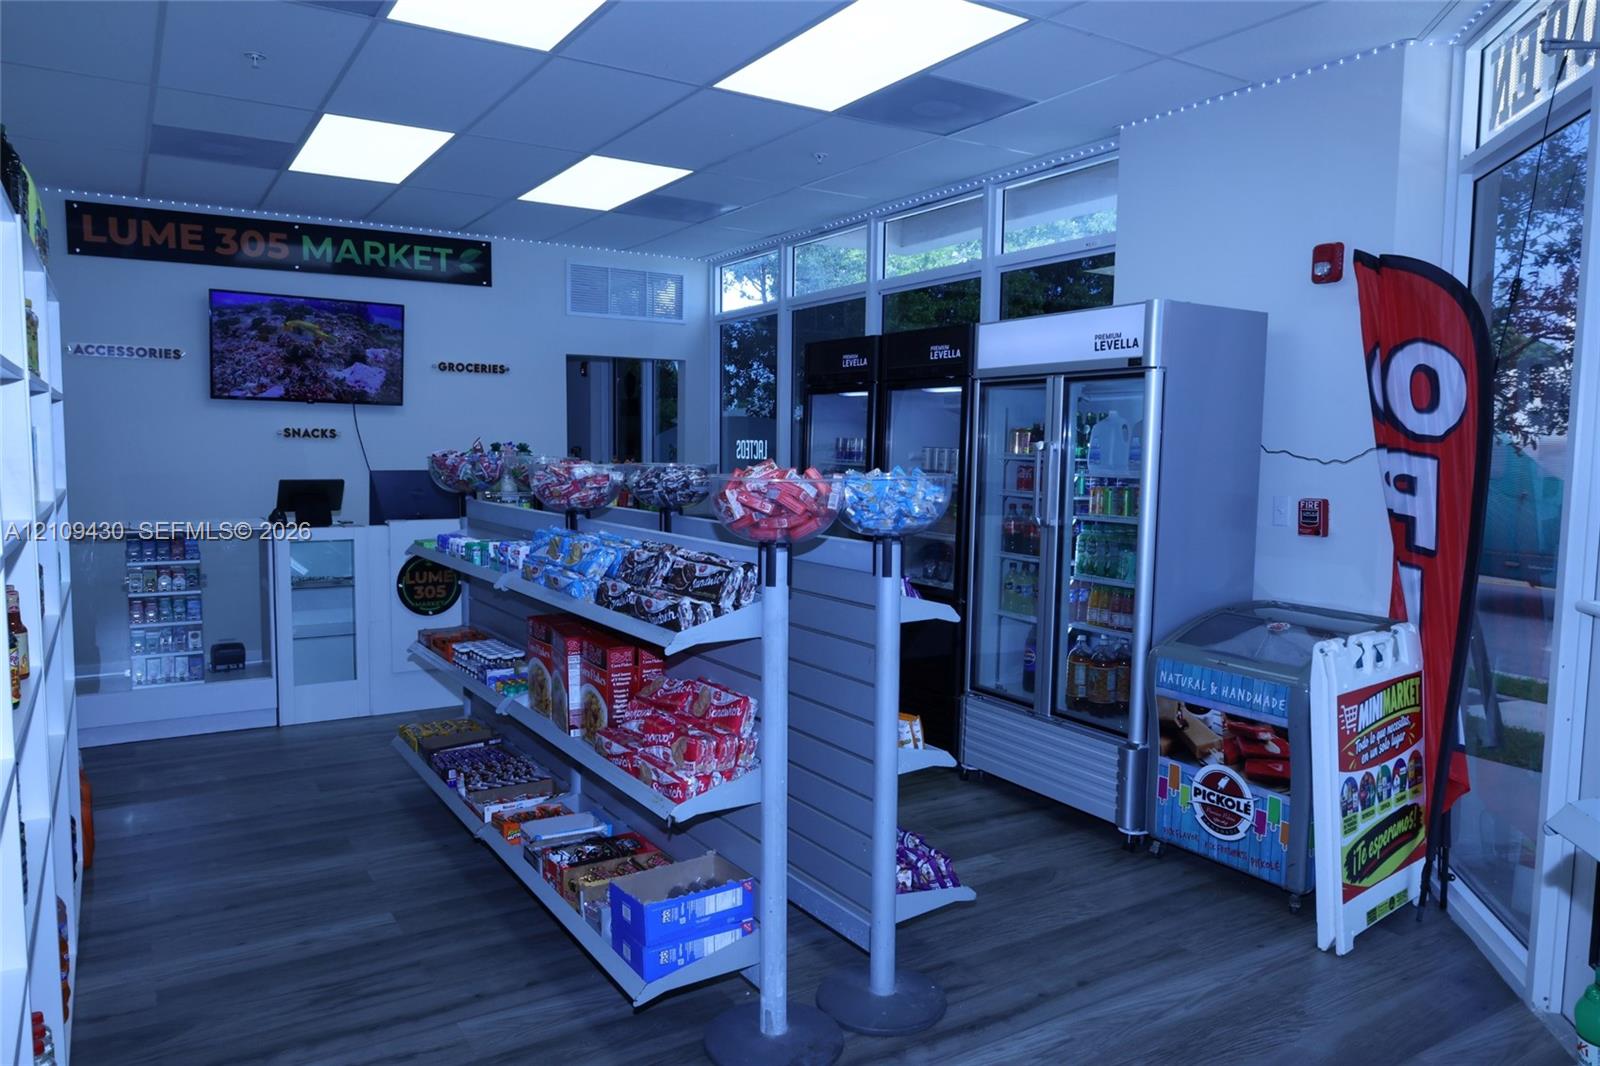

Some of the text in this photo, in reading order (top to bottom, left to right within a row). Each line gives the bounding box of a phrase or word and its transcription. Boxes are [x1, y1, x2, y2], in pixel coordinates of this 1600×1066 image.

[82, 213, 454, 274] LUME 305 MARKET
[1094, 332, 1122, 340] PREMIUM
[73, 343, 182, 361] ACCESSORIES
[1094, 337, 1140, 352] LEVELLA
[929, 348, 962, 360] LEVELLA
[438, 361, 506, 375] GROCERIES
[842, 357, 868, 368] LEVELLA
[283, 427, 337, 440] SNACKS
[1300, 501, 1320, 510] FIRE
[405, 570, 453, 586] LUME
[413, 585, 447, 600] 305
[1159, 670, 1288, 711] NATURAL & HANDMADE
[1378, 737, 1391, 755] solo
[1391, 731, 1406, 750] lugar
[1193, 786, 1252, 816] PICKOLÉ
[1368, 809, 1418, 861] esperamos!
